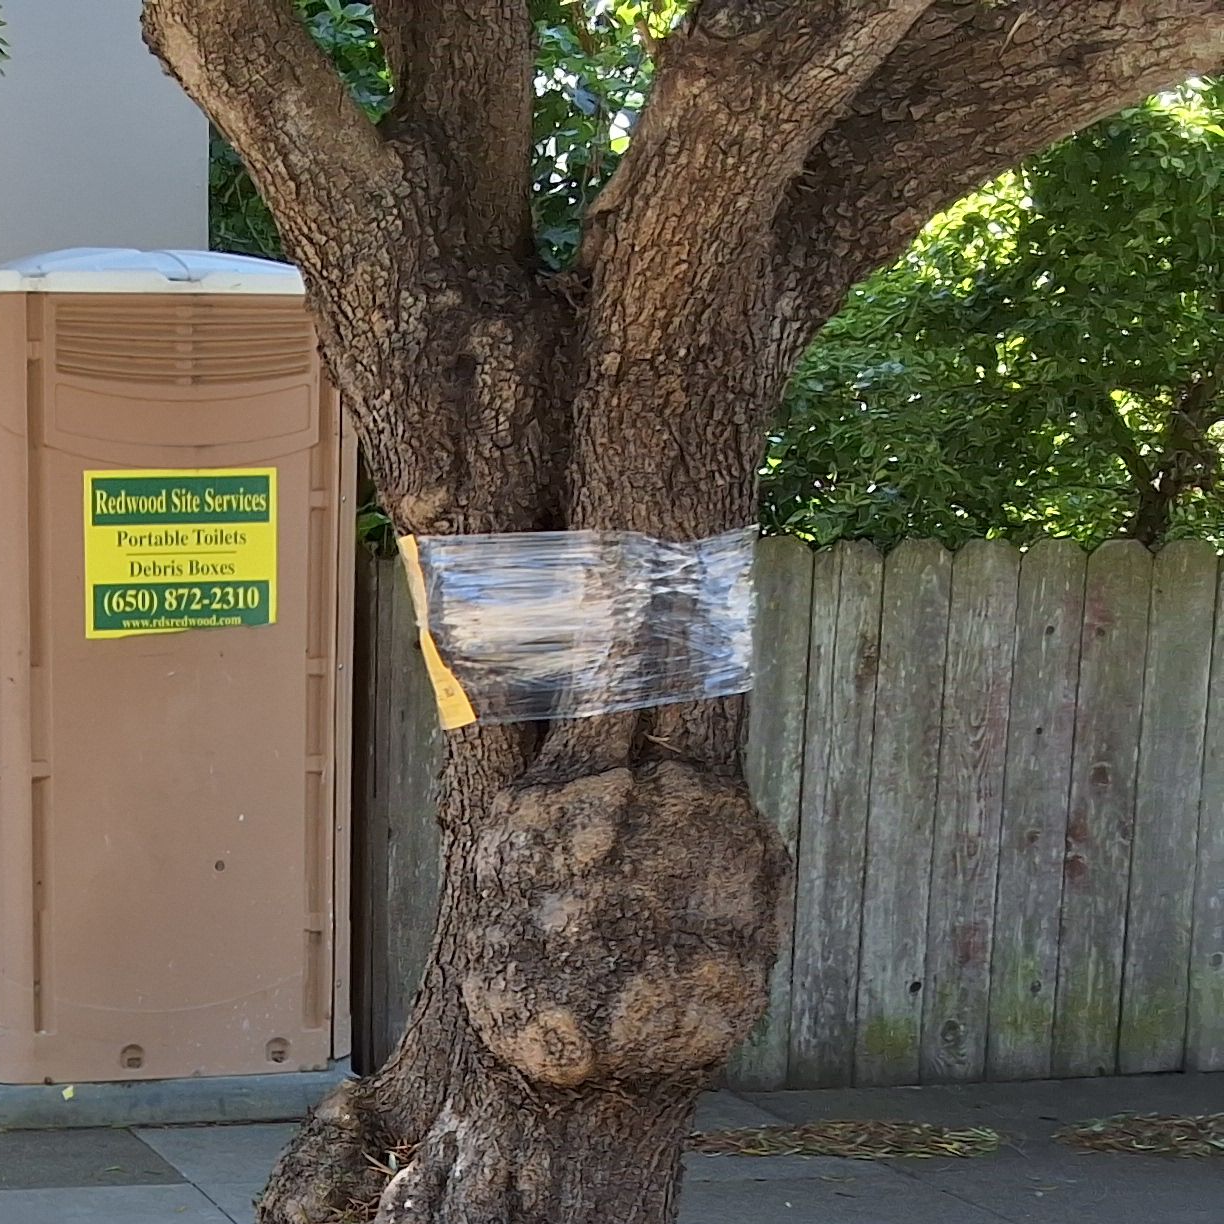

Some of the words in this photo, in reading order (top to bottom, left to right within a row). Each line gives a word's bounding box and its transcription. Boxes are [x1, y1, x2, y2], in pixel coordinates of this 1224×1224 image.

[95, 490, 166, 515] Redwood
[171, 488, 200, 513] Site
[204, 487, 267, 513] Services
[116, 530, 189, 548] Portable
[192, 528, 247, 546] Toilets
[129, 560, 183, 578] Debris
[188, 559, 236, 577] Boxes
[103, 589, 158, 616] (650)
[164, 586, 260, 612] 872-2310
[122, 615, 242, 629] www.rdsredwood.com
